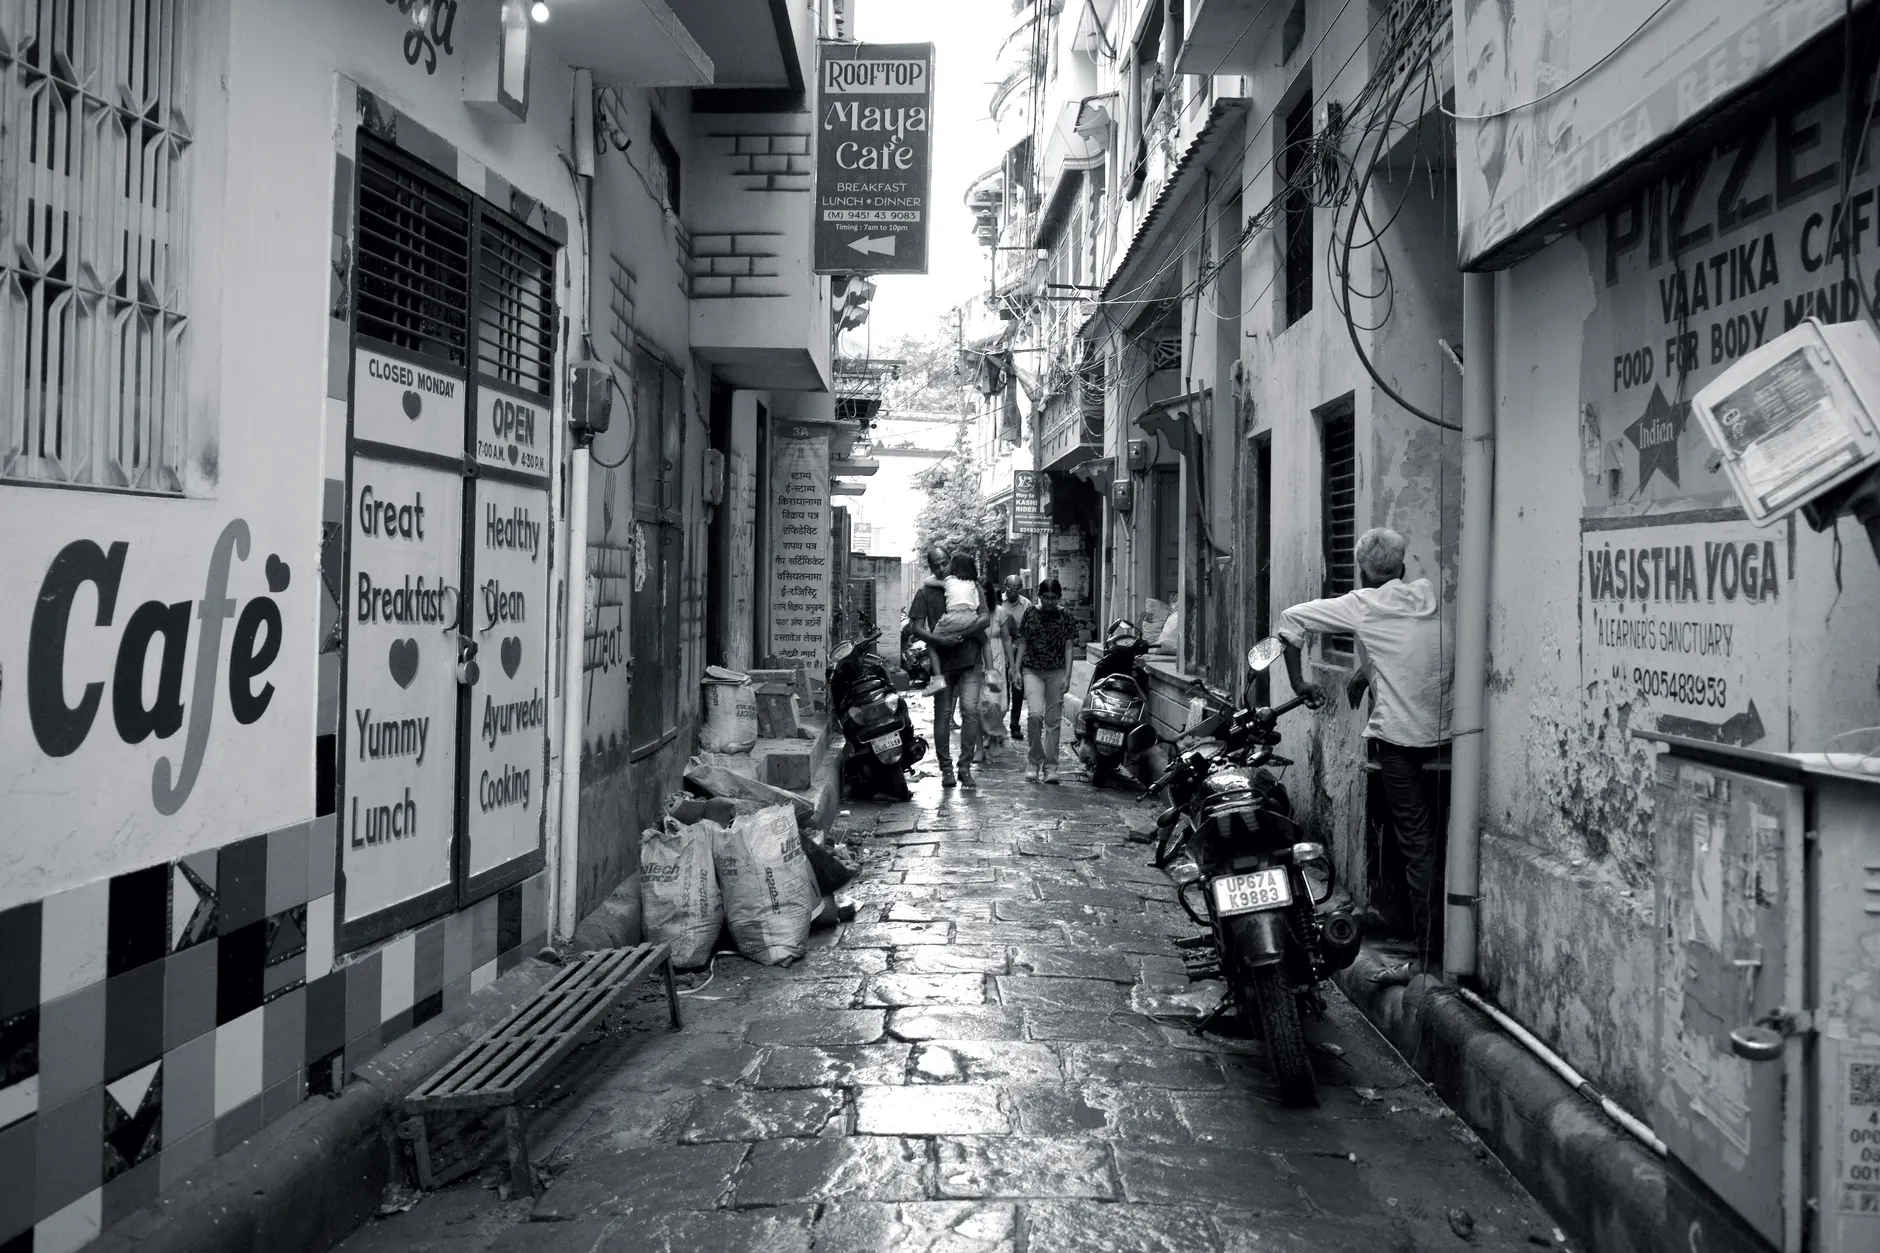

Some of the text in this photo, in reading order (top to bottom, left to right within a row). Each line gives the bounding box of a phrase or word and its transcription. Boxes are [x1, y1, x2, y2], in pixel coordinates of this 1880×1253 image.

[828, 61, 923, 92] ROOFTOP
[824, 101, 926, 144] Maya
[822, 196, 921, 206] LUNCH DINNER
[837, 182, 908, 192] BREAKFAST
[827, 211, 916, 220] (M) 9451 43 9083
[835, 223, 858, 232] Timing
[889, 224, 908, 233] 10pm
[1658, 232, 1780, 325] VAATIKA
[1800, 186, 1880, 273] CAF
[1613, 345, 1654, 393] FOOD
[1666, 330, 1699, 378] FOR
[368, 358, 455, 399] CLOSED MONDAY
[492, 397, 536, 448] OPEN
[792, 426, 809, 437] 3A
[1639, 418, 1675, 449] Indian
[785, 482, 816, 495] ई-स्टाम्प
[789, 472, 812, 480] स्टाम्प
[358, 485, 425, 540] Great
[778, 495, 823, 507] किरायानामा
[782, 508, 820, 521] विक्रय पत्र
[486, 502, 541, 563] Healthy
[782, 524, 818, 536] एफिडेविट
[782, 542, 818, 551] शपथ पत्र
[776, 570, 823, 581] वसियतनामा
[1704, 540, 1780, 605] YOGA
[358, 571, 446, 626] Breakfast
[485, 579, 526, 624] Clean
[773, 632, 823, 643] दस्तावेज लेखन
[1606, 617, 1656, 651] LEARNER'S
[1659, 621, 1734, 658] SANCTUARY
[1633, 667, 1727, 708] 9005483953
[481, 687, 545, 751] Ayurveda
[355, 708, 430, 769] Yummy
[479, 763, 531, 812] Cooking
[351, 786, 417, 850] Lunch
[1226, 871, 1277, 893] UP67A
[1228, 887, 1280, 909] K9883
